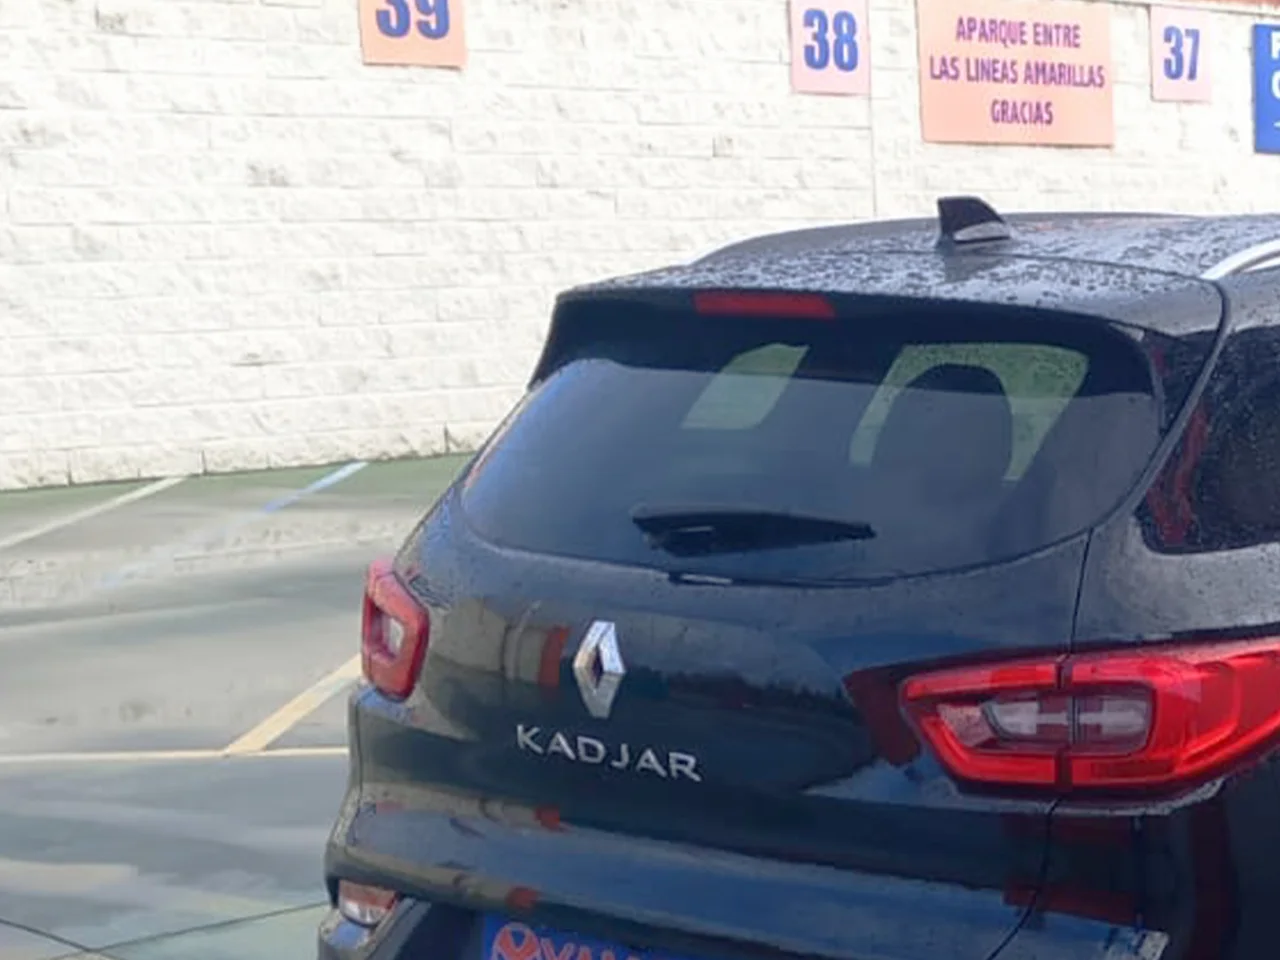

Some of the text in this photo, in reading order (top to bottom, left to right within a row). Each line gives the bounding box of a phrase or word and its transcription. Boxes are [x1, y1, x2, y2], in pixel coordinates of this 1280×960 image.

[375, 0, 450, 40] 39
[956, 16, 1081, 48] APARQUE ENTRE
[803, 10, 859, 72] 38
[1163, 26, 1201, 81] 37
[929, 56, 1105, 88] LAS LINEAS AMARILLAS
[991, 98, 1053, 125] GRACIAS
[516, 724, 702, 782] KADJAR
